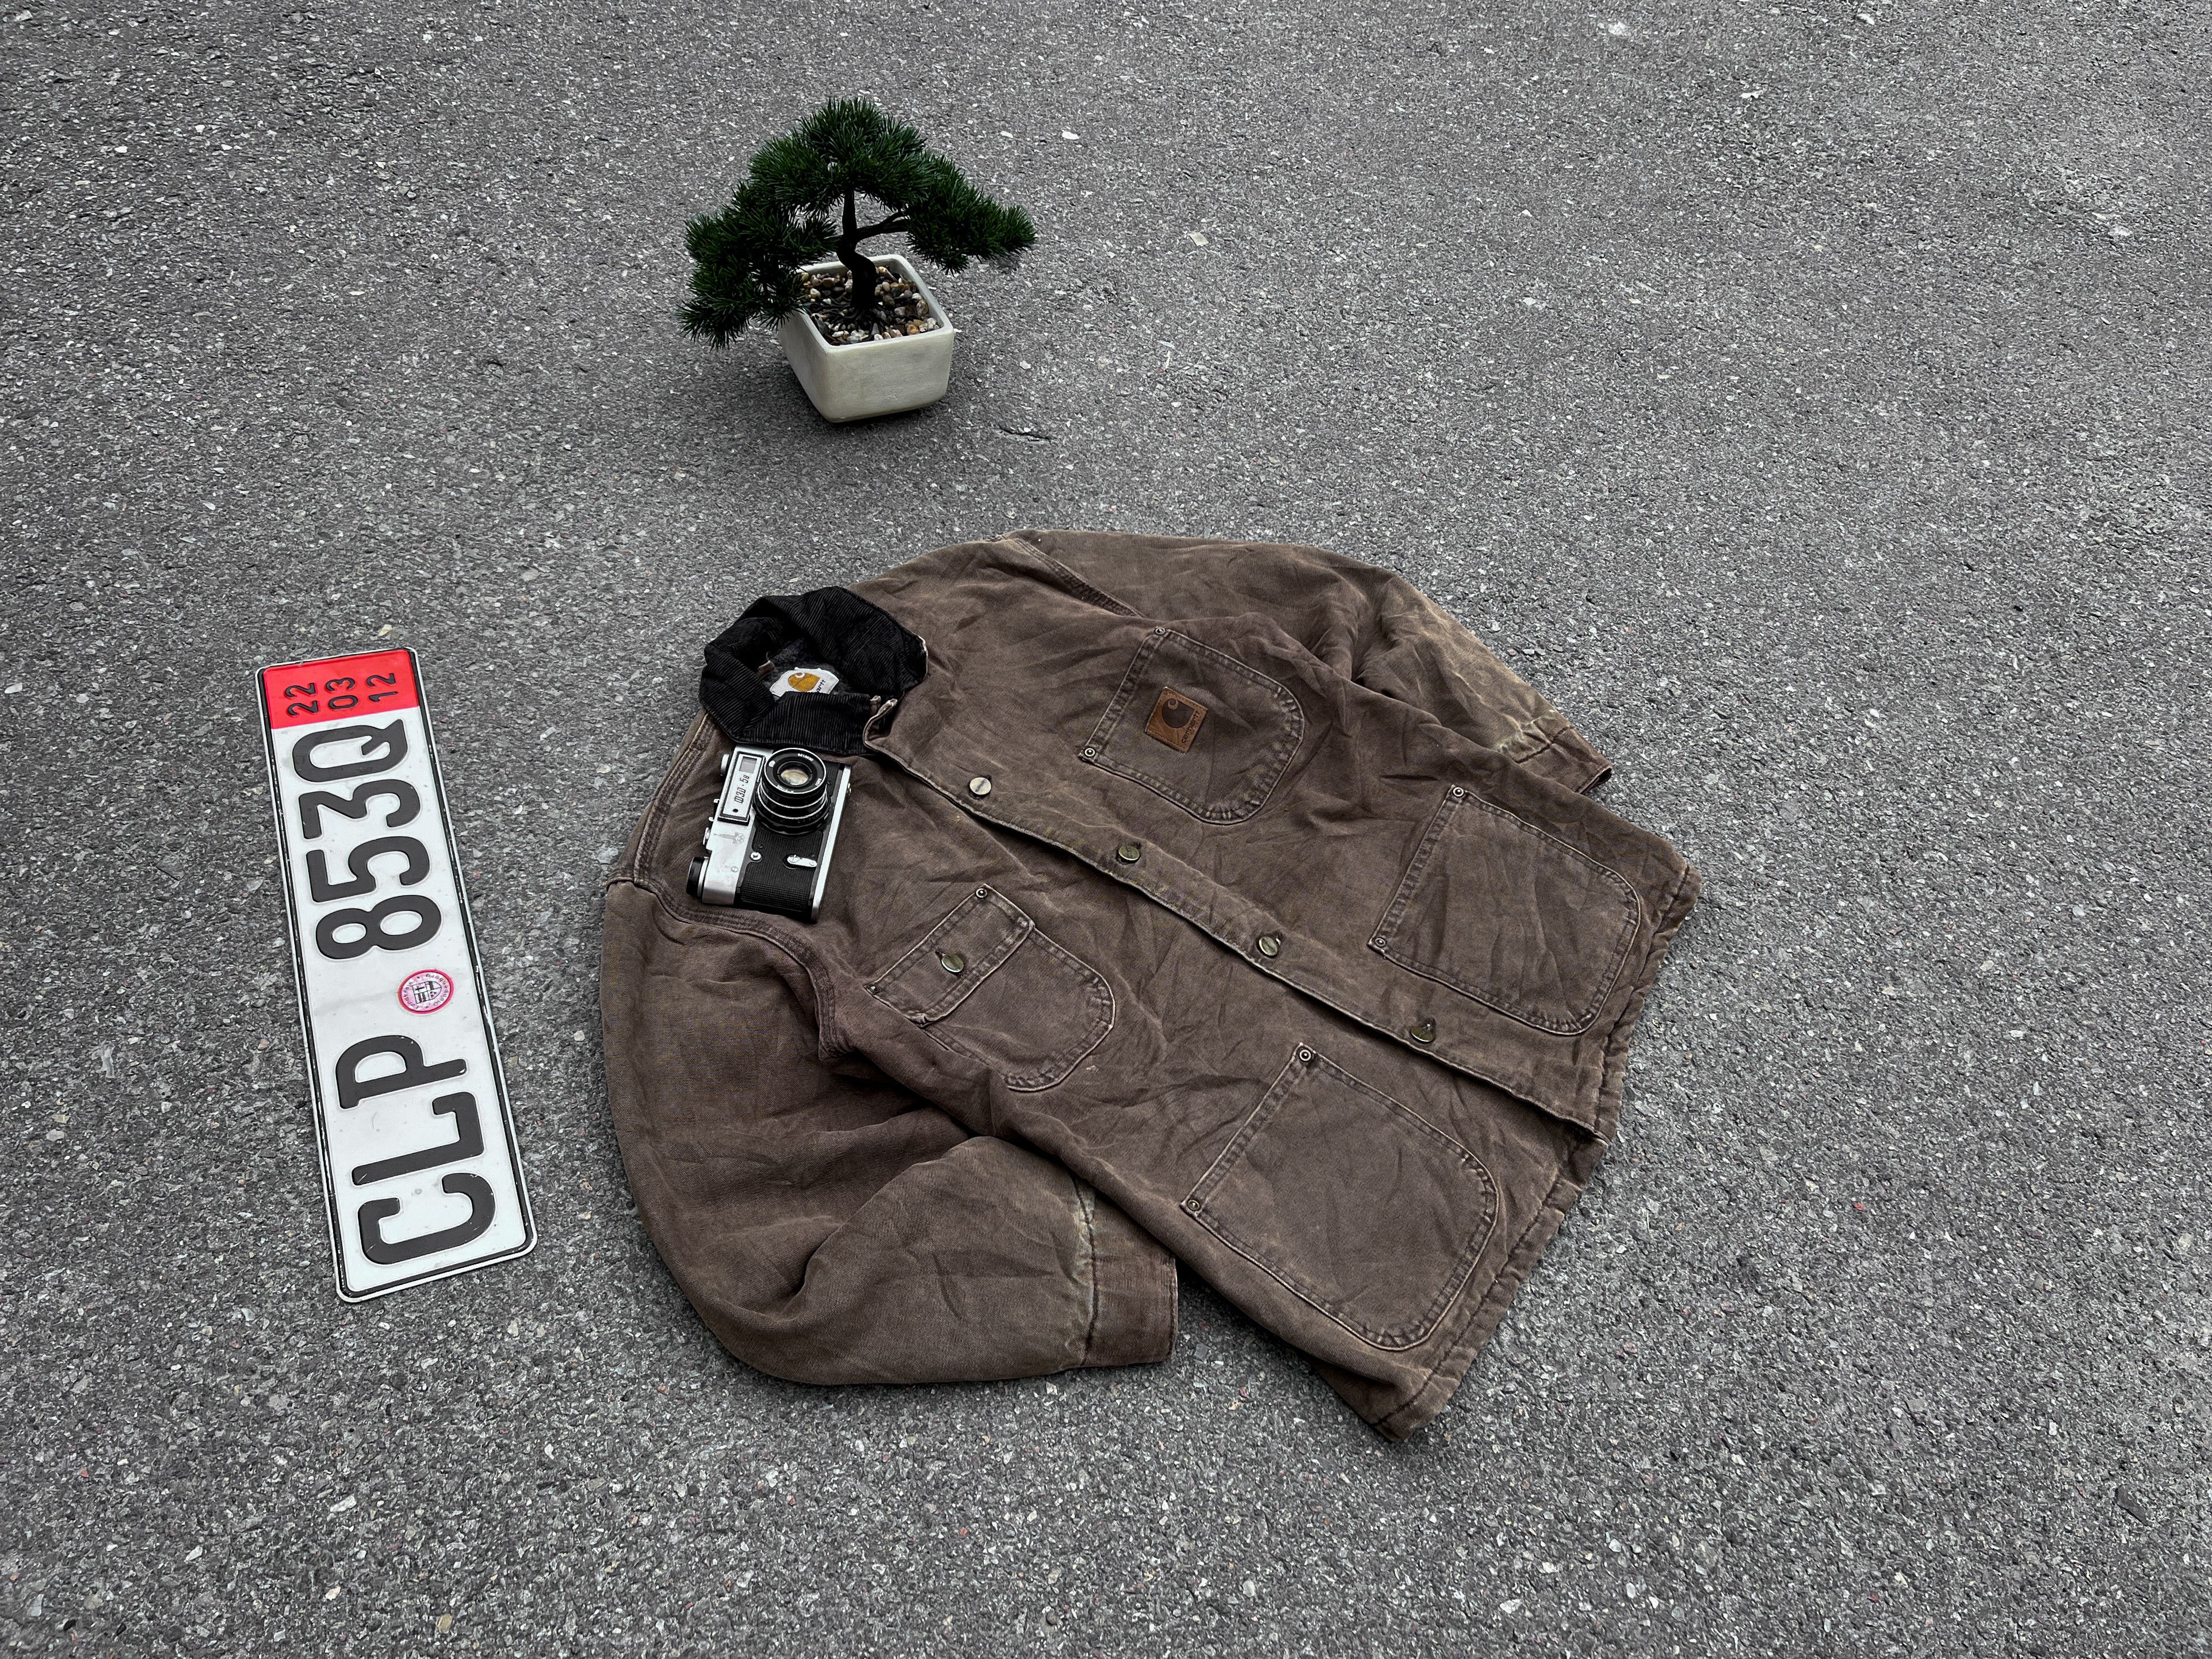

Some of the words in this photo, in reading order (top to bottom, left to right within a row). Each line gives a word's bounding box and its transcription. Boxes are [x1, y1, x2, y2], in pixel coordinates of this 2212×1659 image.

[283, 682, 319, 718] 22
[324, 677, 359, 710] 03
[365, 672, 399, 703] 12
[292, 719, 442, 960] 853Q
[334, 1035, 495, 1265] CLP
